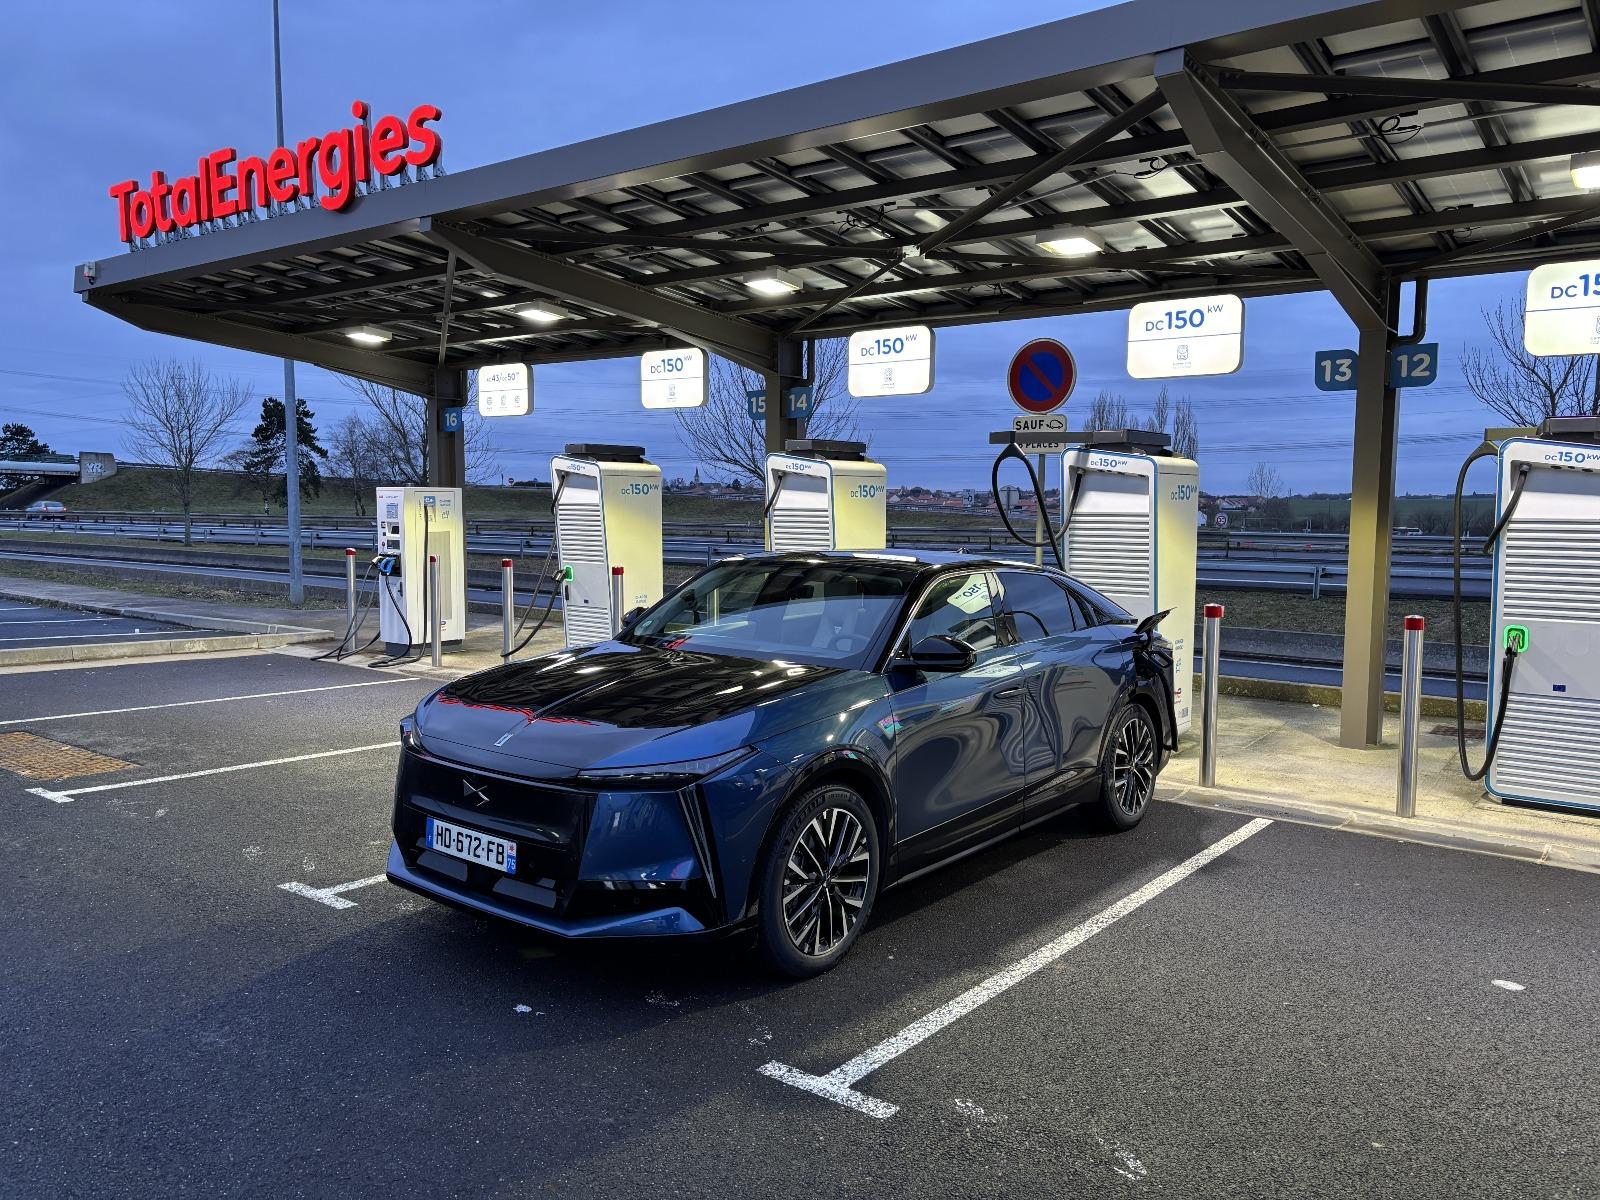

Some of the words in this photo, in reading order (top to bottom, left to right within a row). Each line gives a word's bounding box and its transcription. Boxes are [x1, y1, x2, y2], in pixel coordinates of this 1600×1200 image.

[109, 100, 443, 243] TotalEnergies
[1321, 358, 1352, 382] 13
[1396, 353, 1430, 378] 12
[750, 396, 766, 413] 15
[789, 393, 808, 411] 14
[444, 412, 458, 427] 16
[1015, 419, 1045, 431] SAUF
[507, 858, 516, 870] 75
